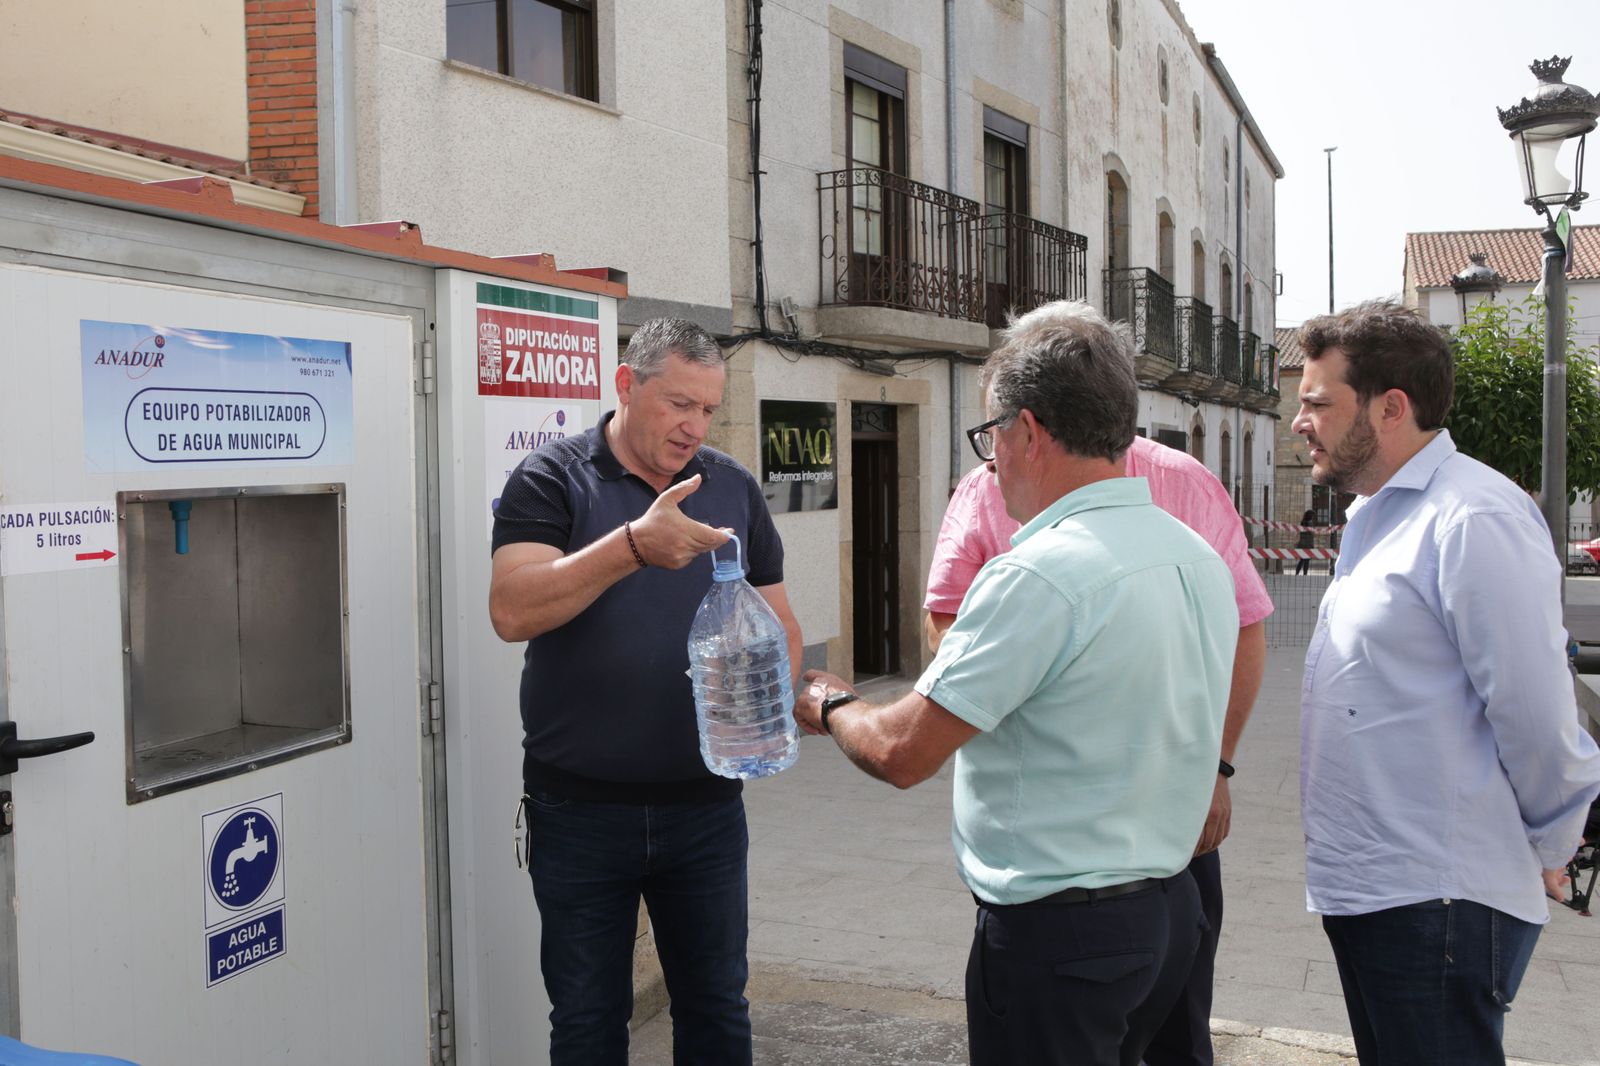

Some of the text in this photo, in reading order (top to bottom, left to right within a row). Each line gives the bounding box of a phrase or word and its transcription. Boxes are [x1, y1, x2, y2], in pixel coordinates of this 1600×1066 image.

[505, 326, 597, 353] DIPUTACIÓN DE
[94, 349, 165, 368] ANADUR
[290, 355, 342, 366] www.anadur.net
[505, 351, 598, 386] ZAMORA
[143, 402, 311, 422] EQUIPO POTABILIZADOR
[158, 432, 301, 452] DE AGUA MUNICIPAL
[769, 470, 834, 483] Reformas integrales
[0, 506, 115, 529] CADA PULSACIÓN:
[36, 532, 82, 548] 5 litros
[228, 921, 267, 949] AGUA
[217, 936, 278, 975] POTABLE
